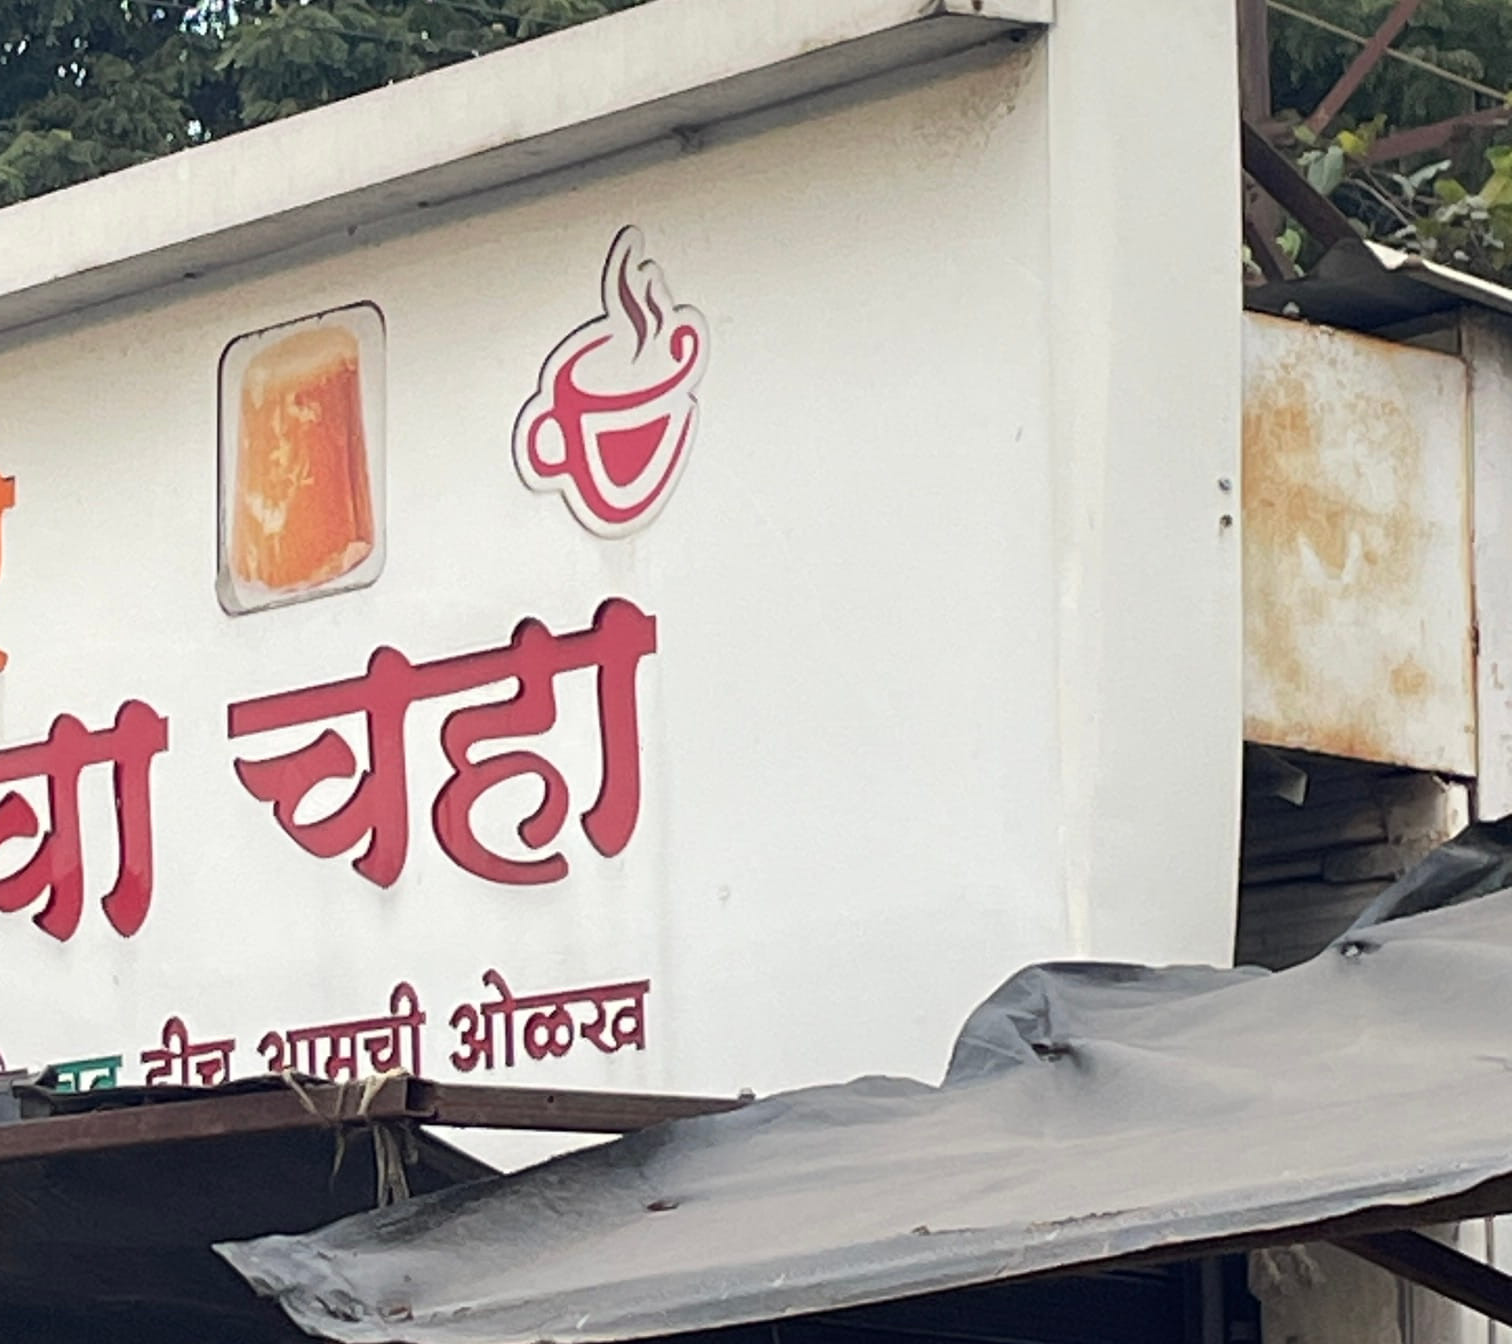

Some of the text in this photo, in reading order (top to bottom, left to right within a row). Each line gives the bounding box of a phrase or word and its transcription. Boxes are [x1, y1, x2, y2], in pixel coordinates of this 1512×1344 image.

[227, 597, 656, 889] चहा
[258, 981, 426, 1084] आमची
[449, 968, 650, 1072] ओळख
